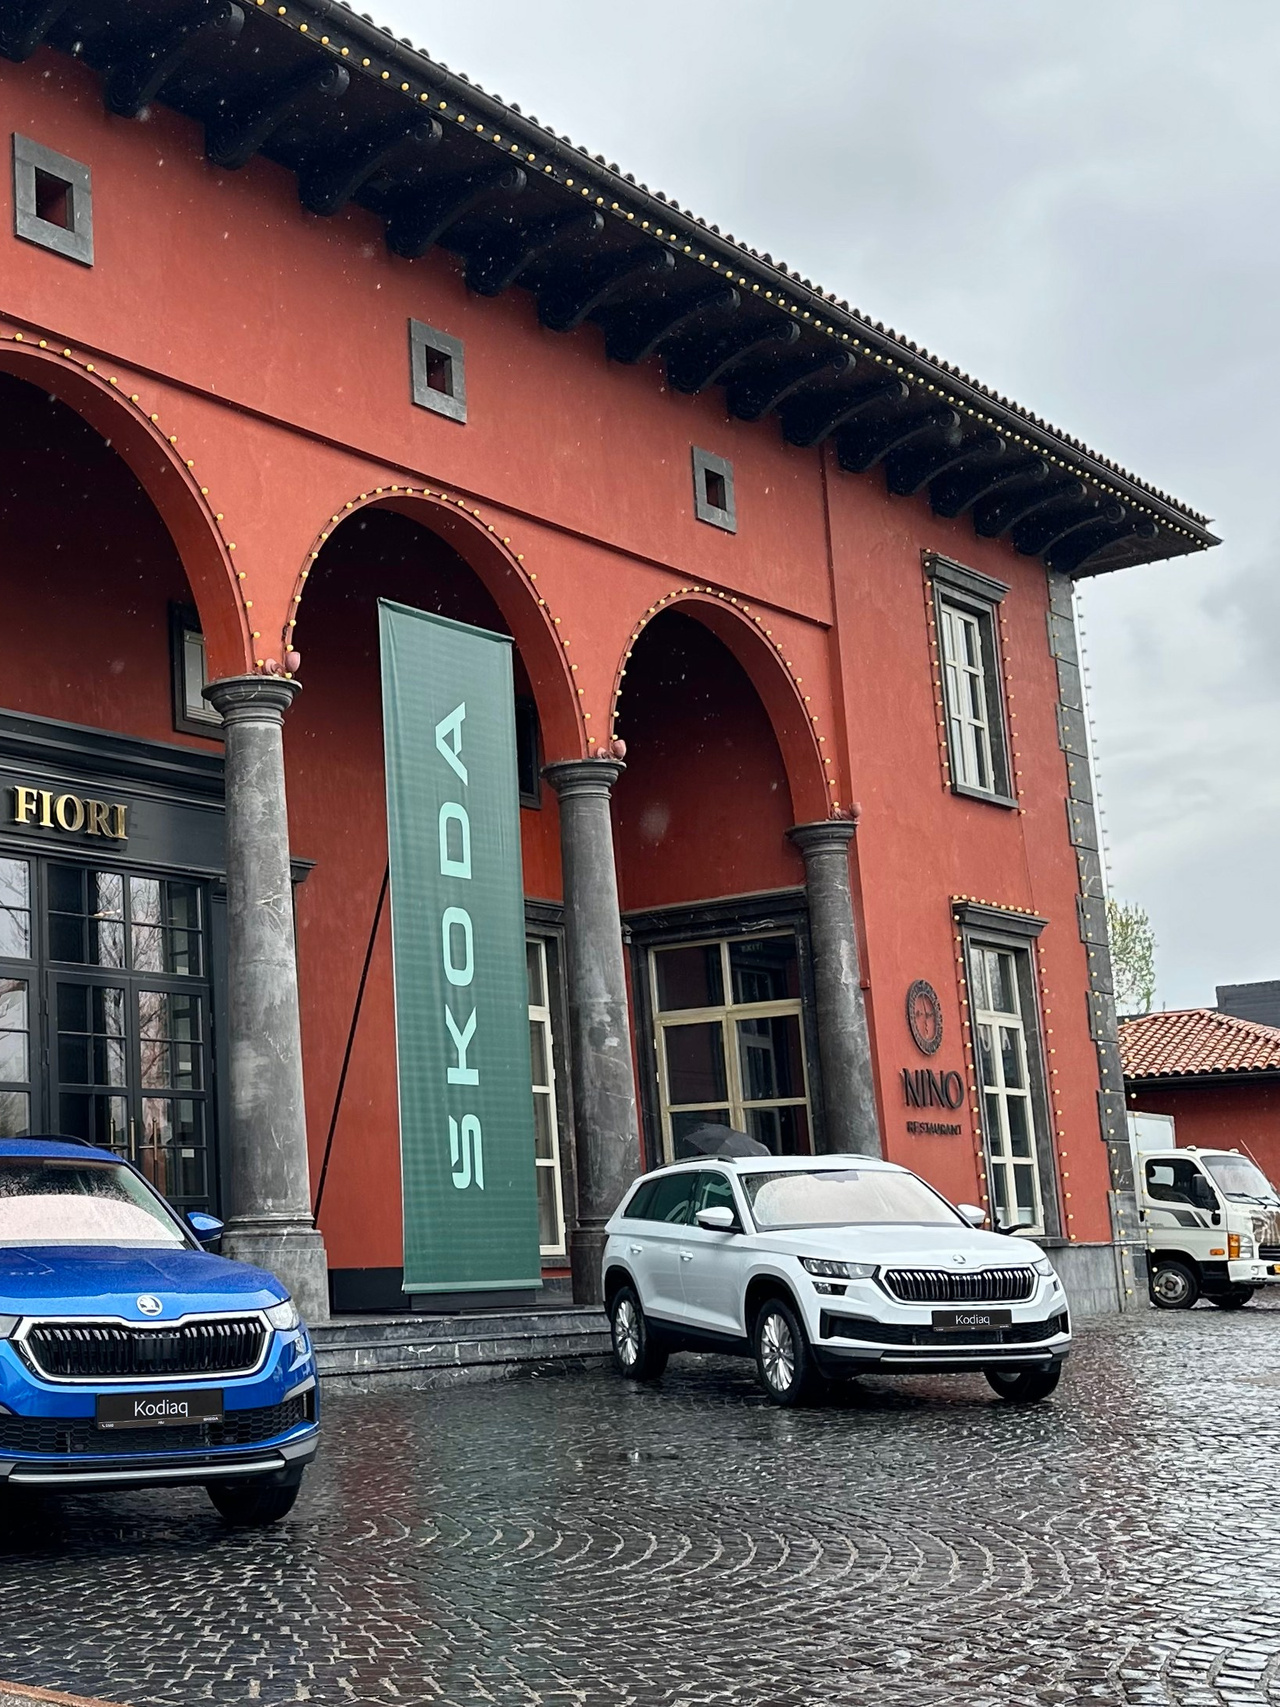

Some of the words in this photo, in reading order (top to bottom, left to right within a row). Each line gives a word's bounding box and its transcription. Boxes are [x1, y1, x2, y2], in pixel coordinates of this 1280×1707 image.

[14, 785, 129, 840] FIORI
[900, 1068, 964, 1110] NINO
[906, 1120, 962, 1136] RESTAURANT
[955, 1314, 990, 1326] Kodiaq
[134, 1399, 189, 1417] Kodiaq
